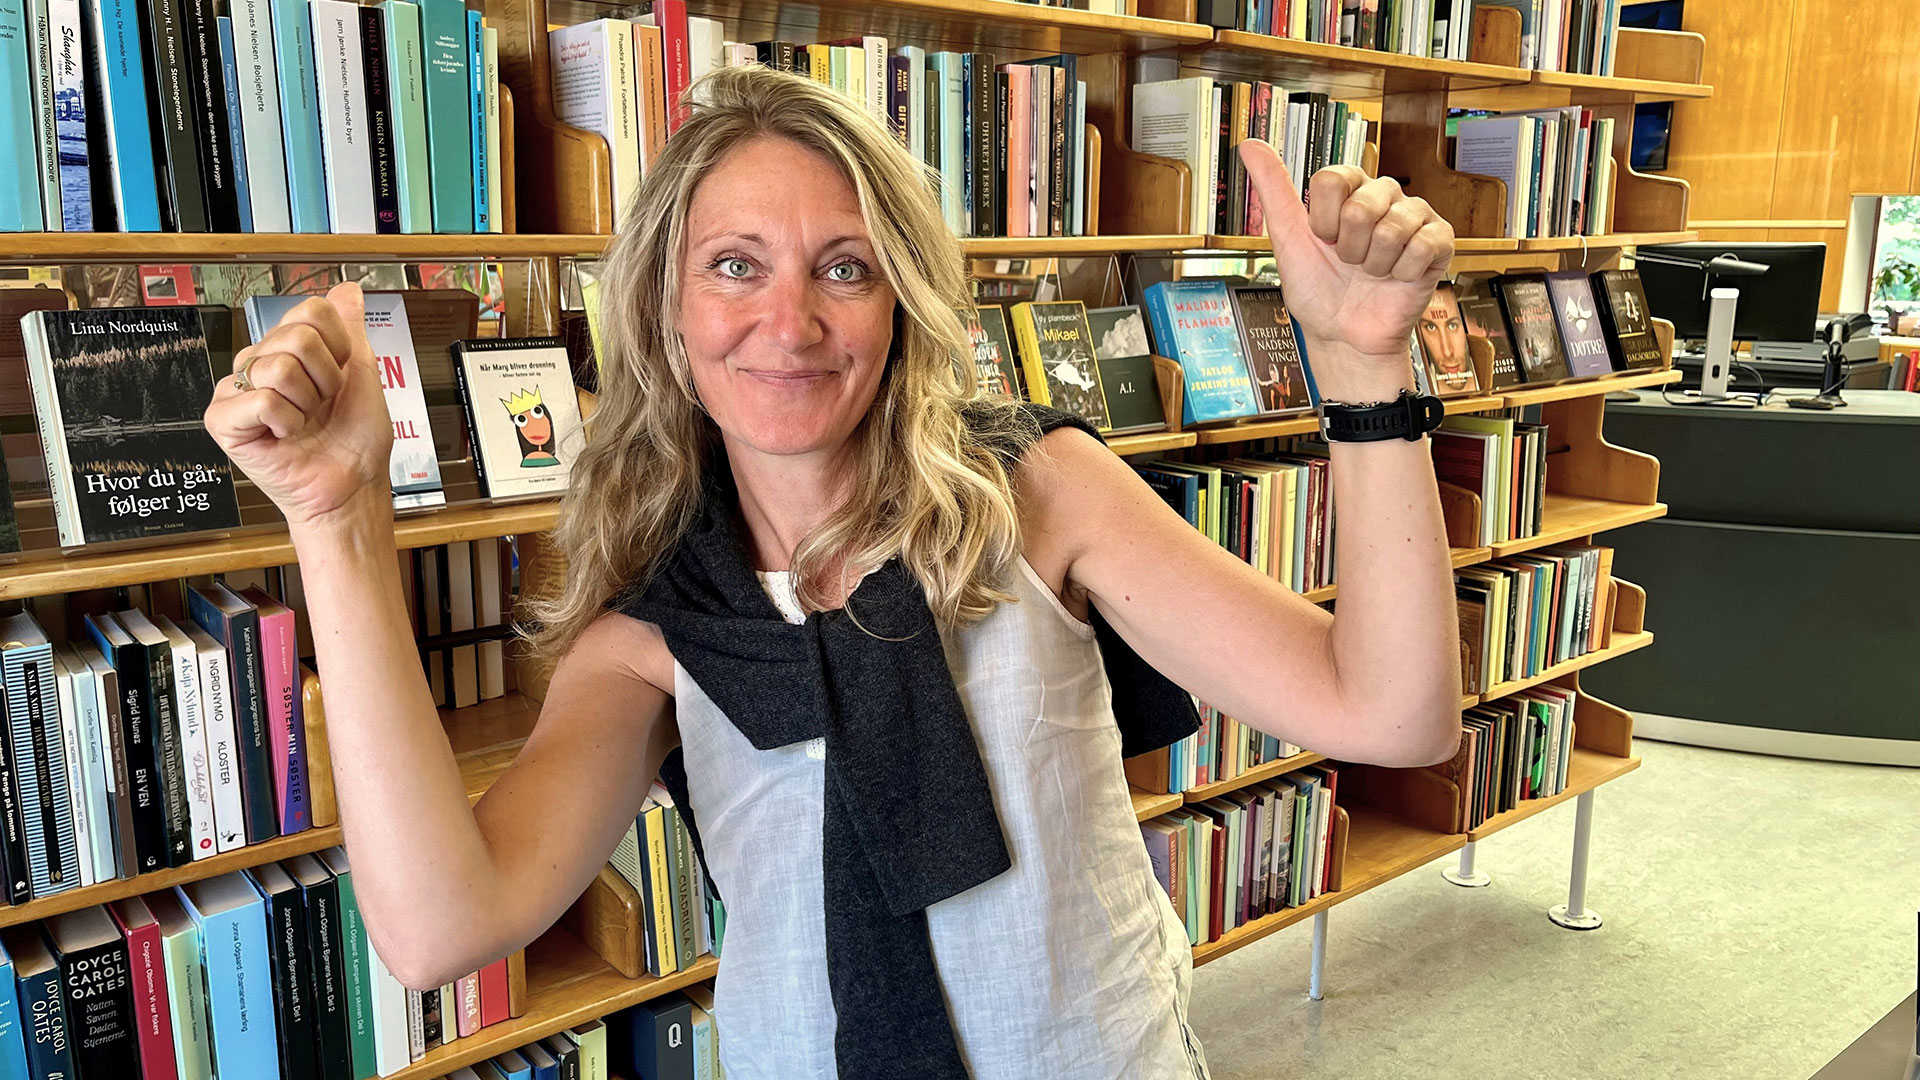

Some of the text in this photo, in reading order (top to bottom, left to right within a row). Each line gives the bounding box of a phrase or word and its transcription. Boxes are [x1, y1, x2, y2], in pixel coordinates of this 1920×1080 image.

[337, 19, 346, 34] Jørn
[60, 26, 76, 76] Shanghai
[168, 37, 176, 65] Nielsen:
[250, 30, 259, 62] Nielsen:
[338, 36, 348, 56] Jønke
[201, 58, 213, 107] Stonelegenderne
[253, 65, 265, 112] Bolsjehjerte
[38, 16, 55, 182] Håkan Nesser: Nortons filosofiske memoirer
[171, 68, 184, 130] Stonelegenderne
[343, 90, 353, 126] Hundrede
[209, 125, 217, 142] mørke
[346, 128, 354, 144] byer
[211, 145, 219, 156] side
[375, 111, 390, 197] KRIGEN PÅ KARAFAL
[213, 165, 222, 188] skyggen
[1175, 300, 1217, 312] MALIBU
[1430, 310, 1448, 320] NICO
[71, 320, 179, 336] Lina Nordquist
[1043, 328, 1079, 341] Mikael
[1178, 316, 1231, 329] FLAMMER
[1250, 327, 1291, 339] STREIF AF
[1257, 338, 1295, 351] NÅDENS
[480, 361, 556, 372] Når Mary bliver dronning
[1269, 352, 1298, 363] VINGE
[1201, 366, 1234, 377] TAYLOR
[1119, 382, 1136, 394] A.I.
[1191, 380, 1227, 392] JENKINS
[85, 464, 222, 493] Hvor du går,
[108, 491, 210, 518] følger jeg
[27, 669, 40, 720] ASLAK NORE
[180, 665, 199, 728] Kaja Nylund
[208, 659, 224, 721] INGRID NYMO
[243, 627, 254, 653] Katrine
[254, 733, 262, 747] hus
[127, 689, 142, 744] Sigrid Nunez
[282, 686, 294, 730] SØSTER
[288, 734, 297, 754] MIN
[33, 726, 51, 808] HAVETS KIRKEGÅRD
[217, 741, 230, 785] KLOSTER
[135, 769, 150, 807] EN VEN
[289, 760, 302, 803] SØSTER
[1, 771, 17, 842] Penge på lommen
[284, 908, 293, 927] Jonna
[319, 898, 327, 918] Jonna
[348, 909, 356, 928] Jonna
[286, 928, 296, 958] Odgaard:
[320, 919, 330, 947] Odgaard:
[69, 951, 122, 975] JOYCE
[142, 941, 152, 968] Chigozie
[322, 949, 333, 977] Bjørnens
[68, 964, 125, 987] CAROL
[287, 959, 298, 988] Bjørnens
[352, 959, 361, 984] Kampen
[71, 976, 125, 999] OATES
[237, 973, 246, 1010] Shamanens
[291, 989, 300, 1005] kraft.
[326, 979, 335, 994] kraft.
[355, 985, 361, 995] om
[293, 1006, 301, 1016] Del
[327, 995, 335, 1005] Del
[32, 1000, 51, 1043] OATES
[44, 979, 66, 1055] JOYCE CAROL
[240, 1011, 249, 1032] lærling
[668, 1022, 682, 1048] Q
